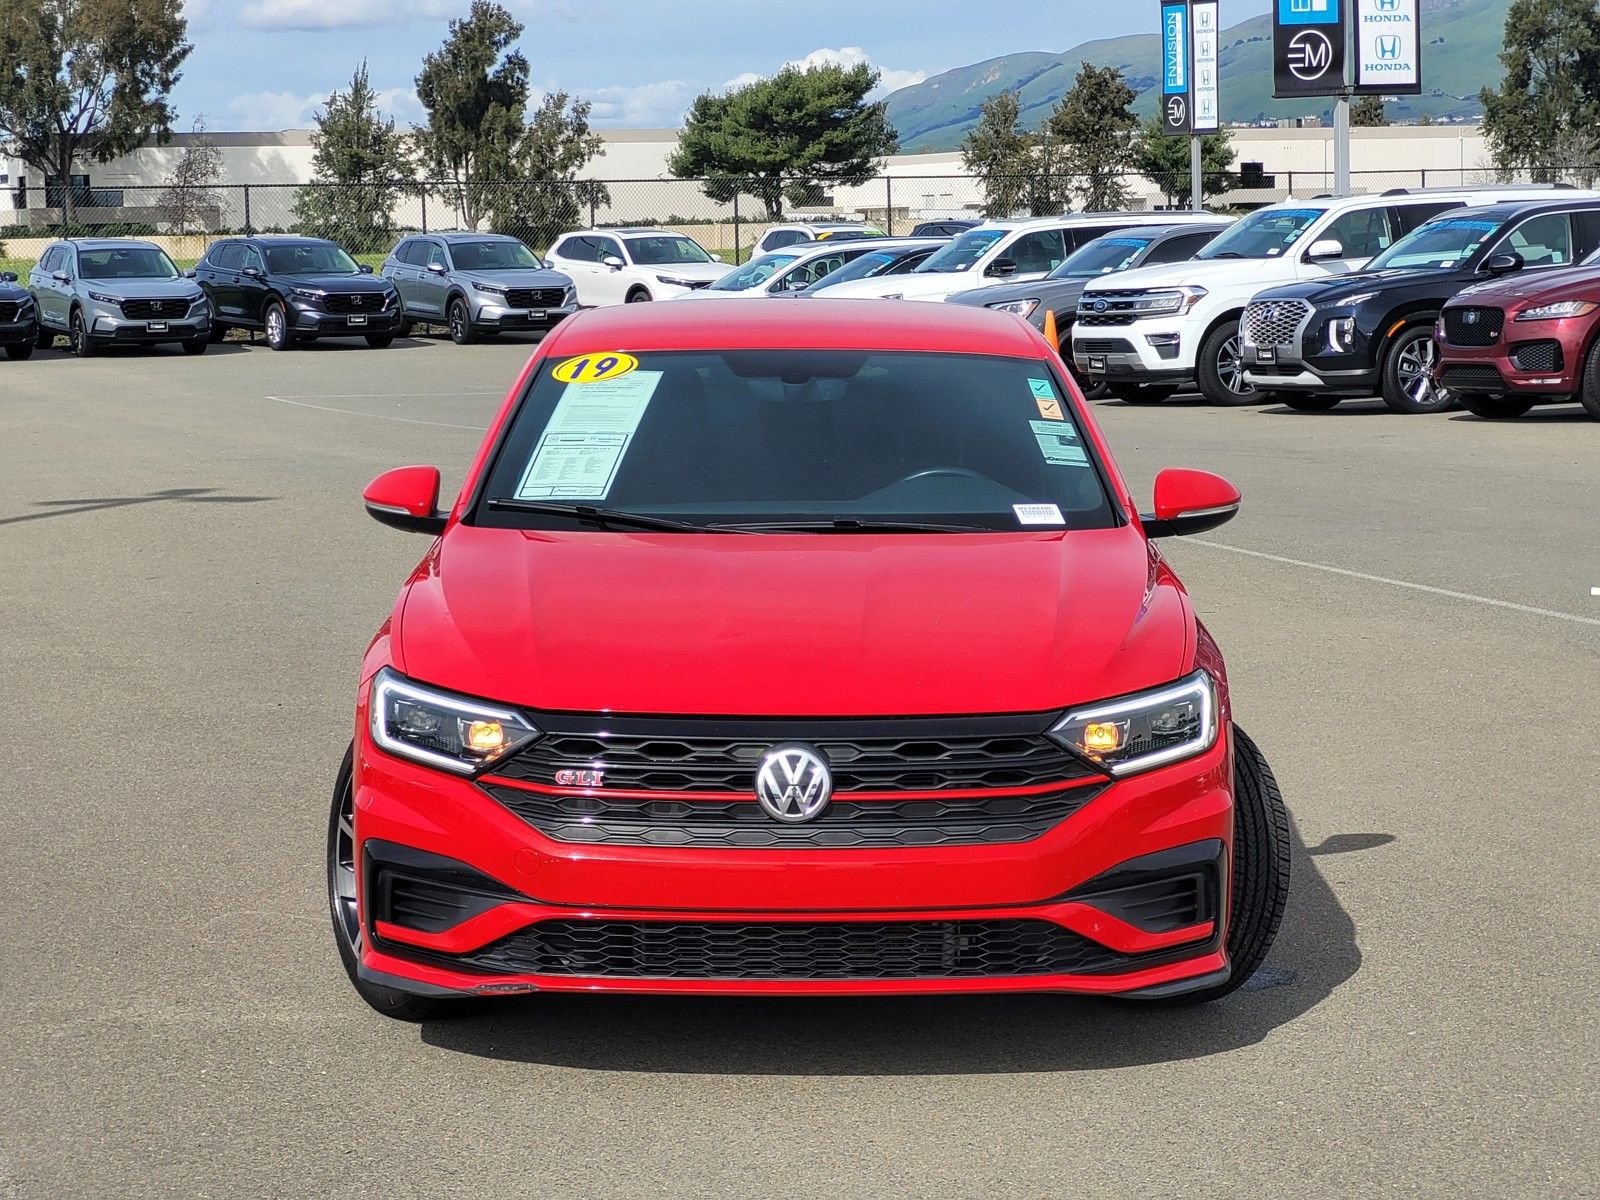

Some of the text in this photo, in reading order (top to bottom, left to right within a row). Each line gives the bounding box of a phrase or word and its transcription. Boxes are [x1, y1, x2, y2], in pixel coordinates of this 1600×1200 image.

[1364, 14, 1411, 23] HONDA
[1167, 12, 1177, 87] ENVISION
[1364, 63, 1412, 72] HONDA
[570, 356, 619, 379] 19
[554, 770, 605, 787] GLI
